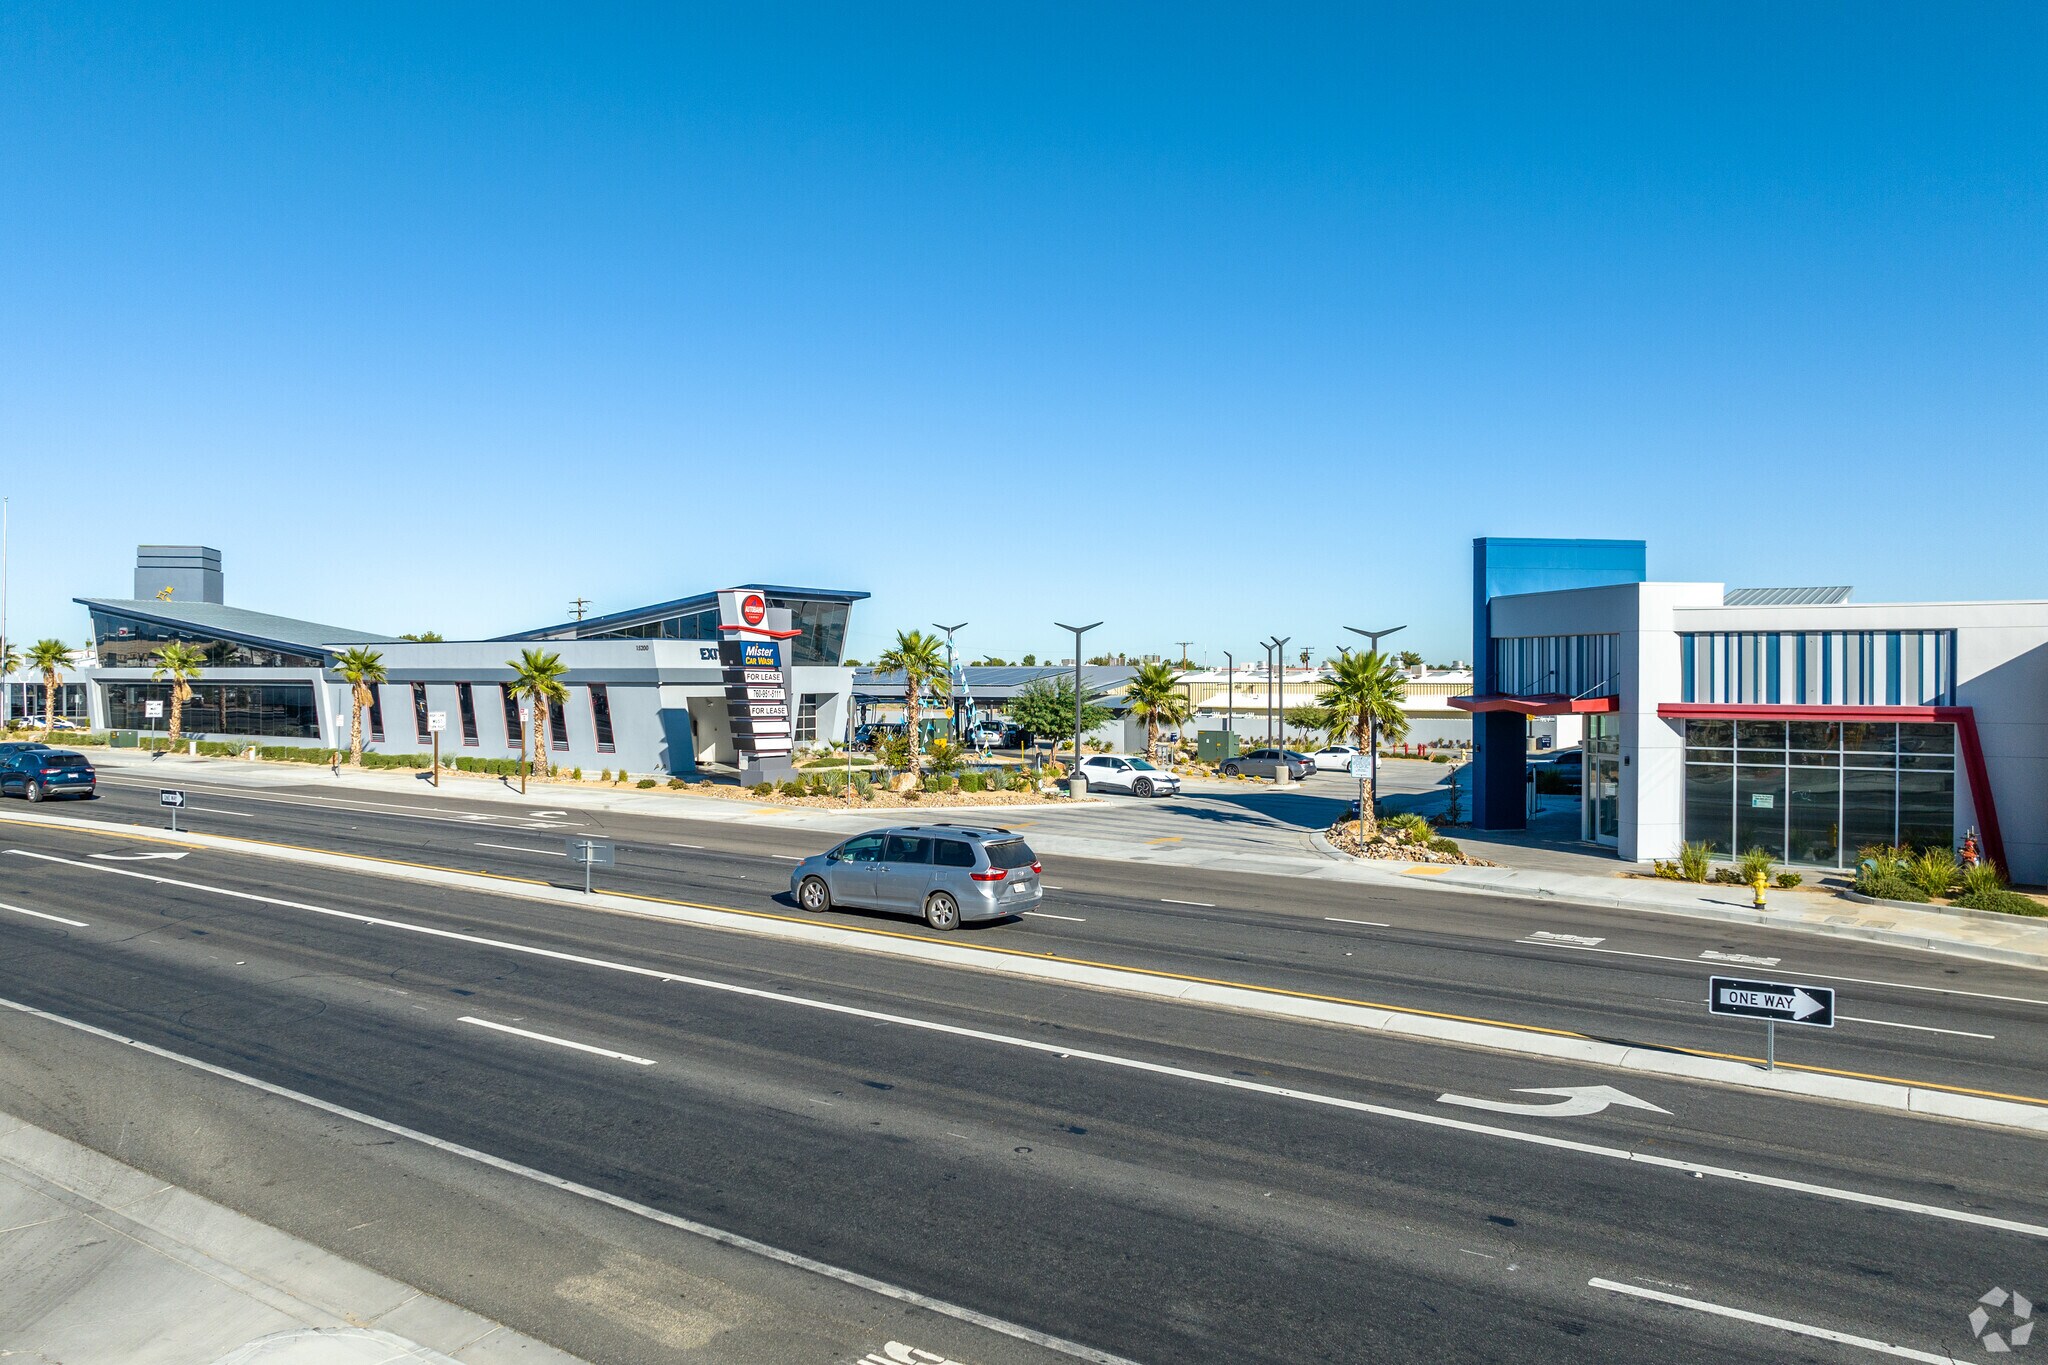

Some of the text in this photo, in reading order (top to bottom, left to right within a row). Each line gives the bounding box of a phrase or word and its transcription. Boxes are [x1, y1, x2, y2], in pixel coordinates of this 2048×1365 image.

[746, 643, 773, 657] Mister
[746, 657, 774, 665] CAR WASH
[1729, 991, 1794, 1009] ONE WAY
